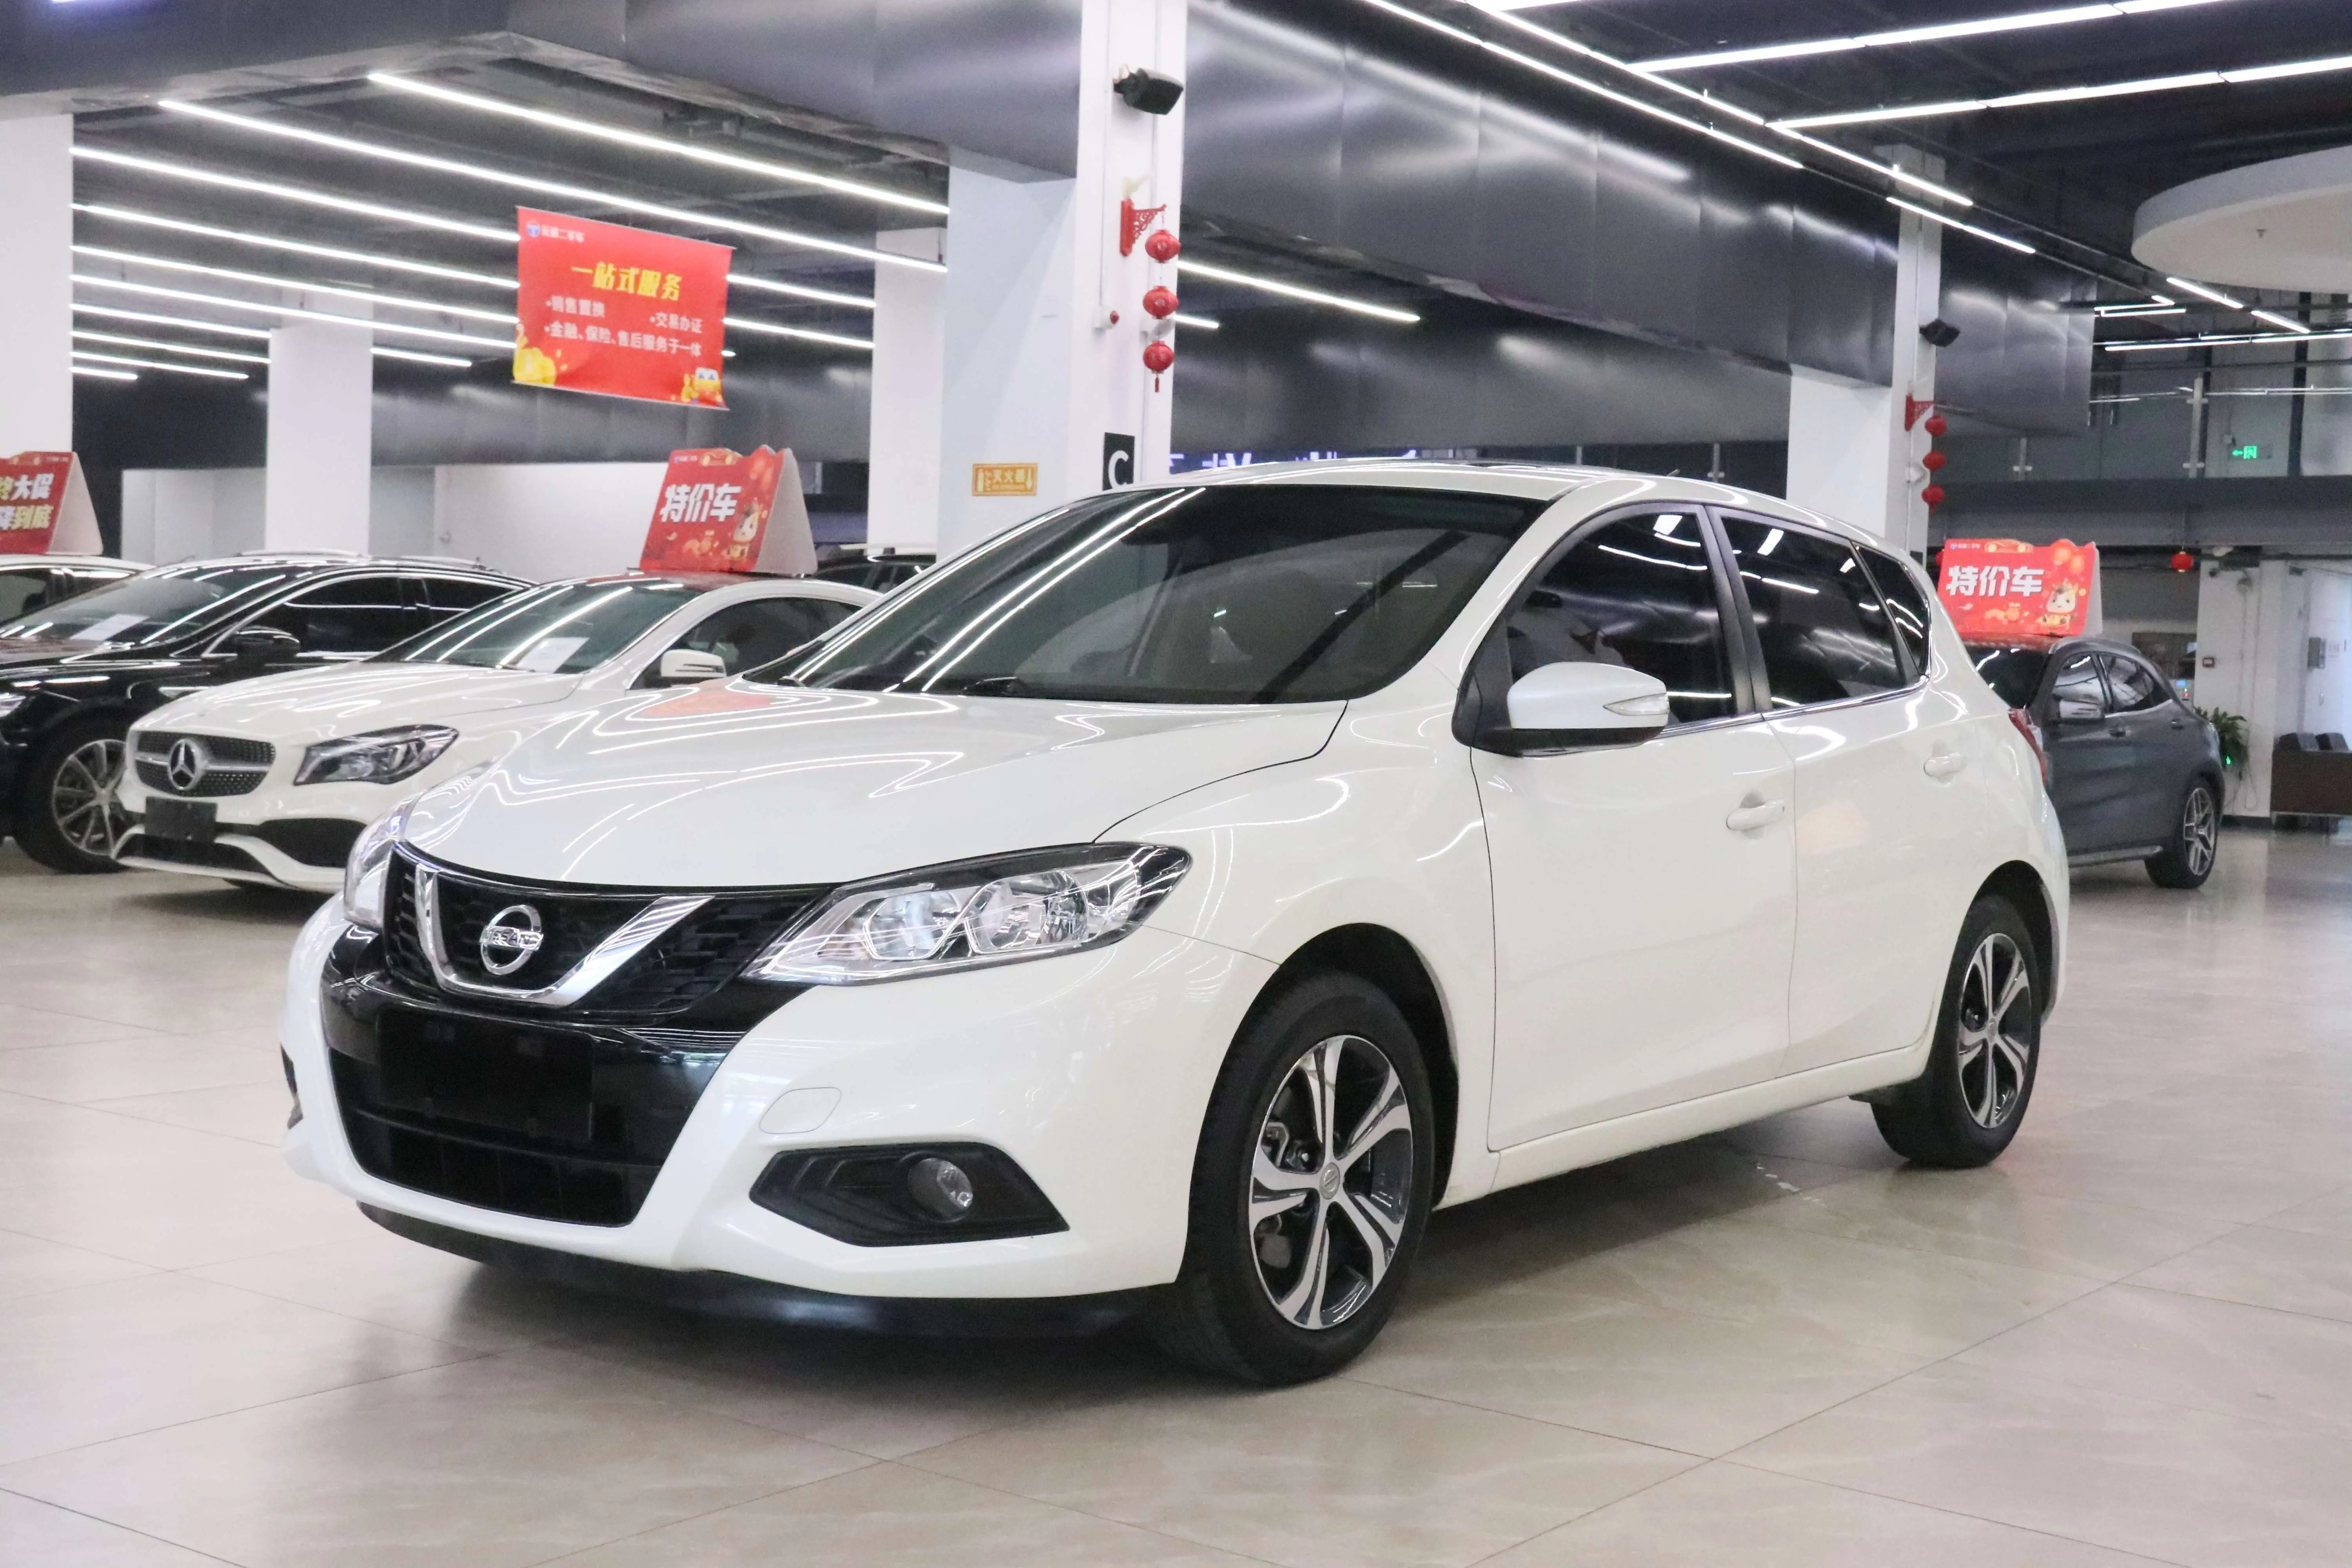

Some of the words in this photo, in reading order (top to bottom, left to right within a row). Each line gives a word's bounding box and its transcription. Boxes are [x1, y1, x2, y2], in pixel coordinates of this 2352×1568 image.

[571, 261, 682, 301] 一站式服务
[552, 296, 605, 318] 销售置换
[655, 312, 702, 334] 交易办证
[1108, 450, 1129, 486] C
[660, 483, 742, 523] 特价车
[1946, 565, 2044, 597] 特价车
